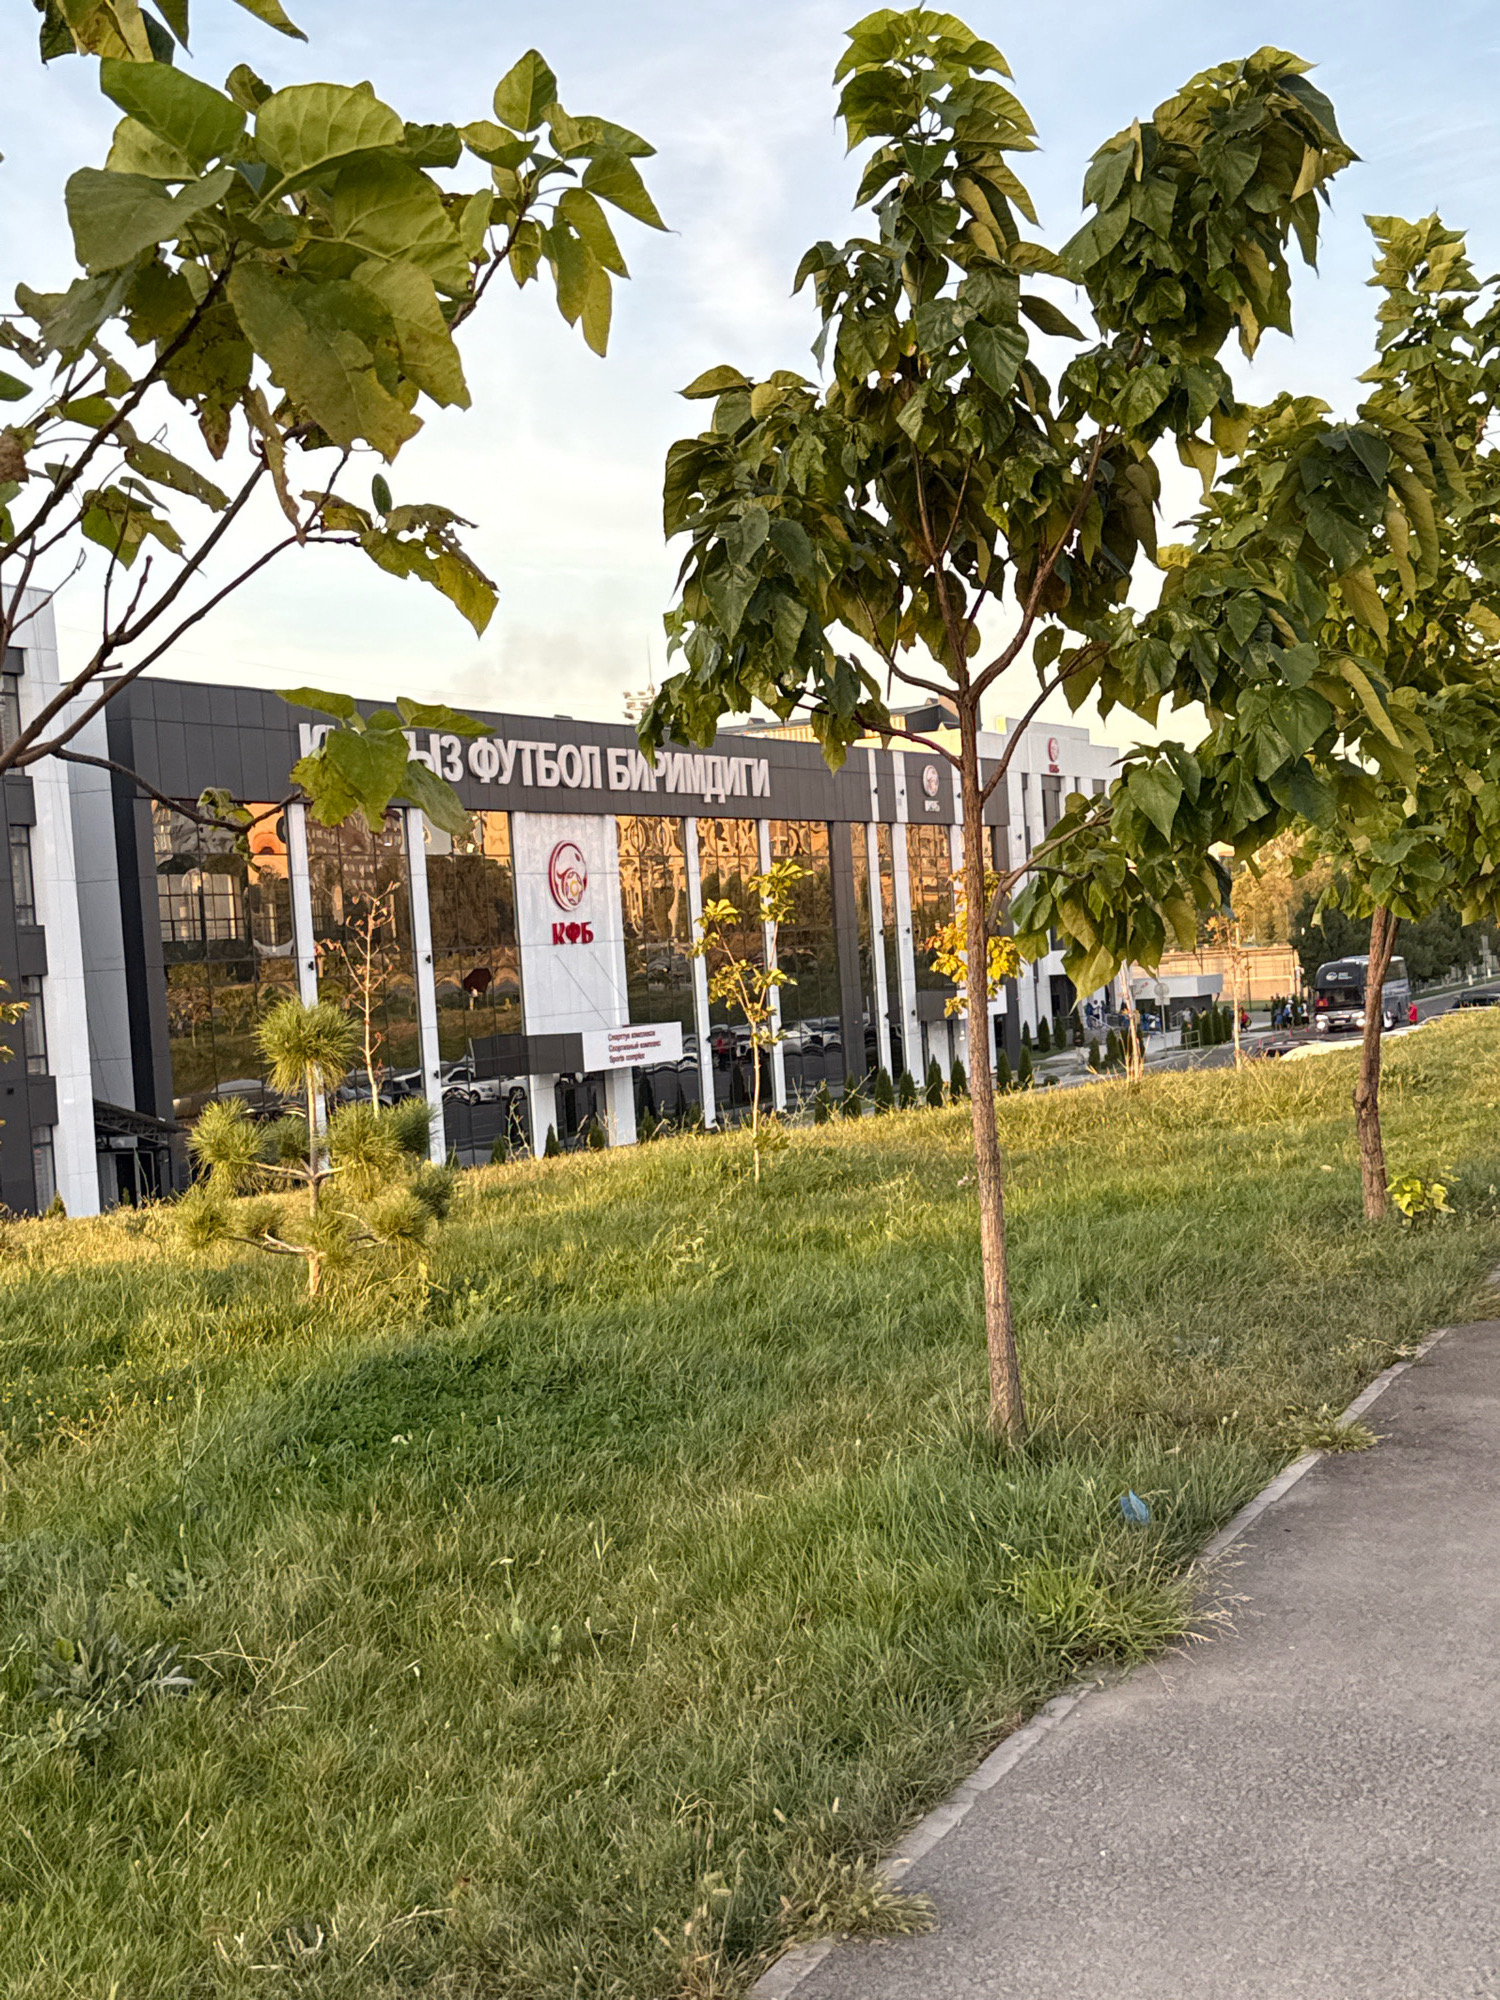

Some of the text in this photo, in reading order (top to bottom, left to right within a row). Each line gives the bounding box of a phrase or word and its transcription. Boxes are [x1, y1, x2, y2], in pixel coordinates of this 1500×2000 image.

[298, 723, 771, 804] КЫЗ ФУТБОЛ БИРИМДИГИ
[551, 921, 594, 945] КФБ
